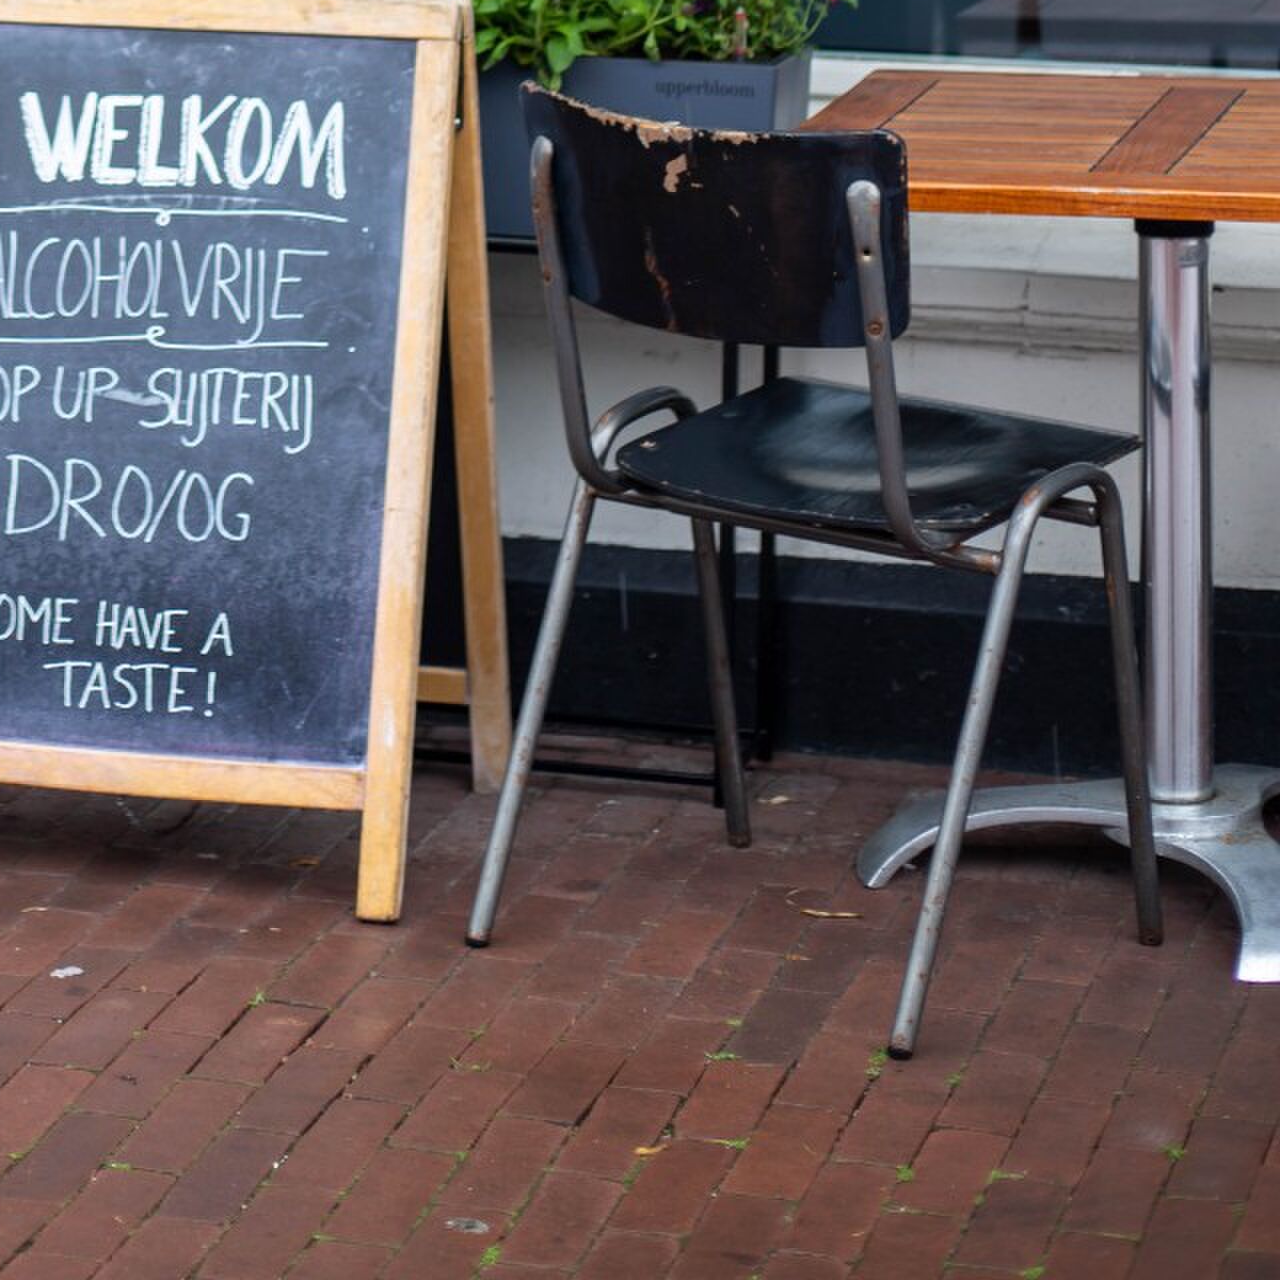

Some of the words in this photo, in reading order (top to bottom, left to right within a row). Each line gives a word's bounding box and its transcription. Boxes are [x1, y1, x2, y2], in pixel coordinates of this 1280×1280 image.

[20, 91, 346, 200] WELKOM
[52, 365, 119, 423] UP
[96, 600, 189, 655] HAVE
[200, 613, 234, 656] A
[42, 661, 217, 717] TASTE!
